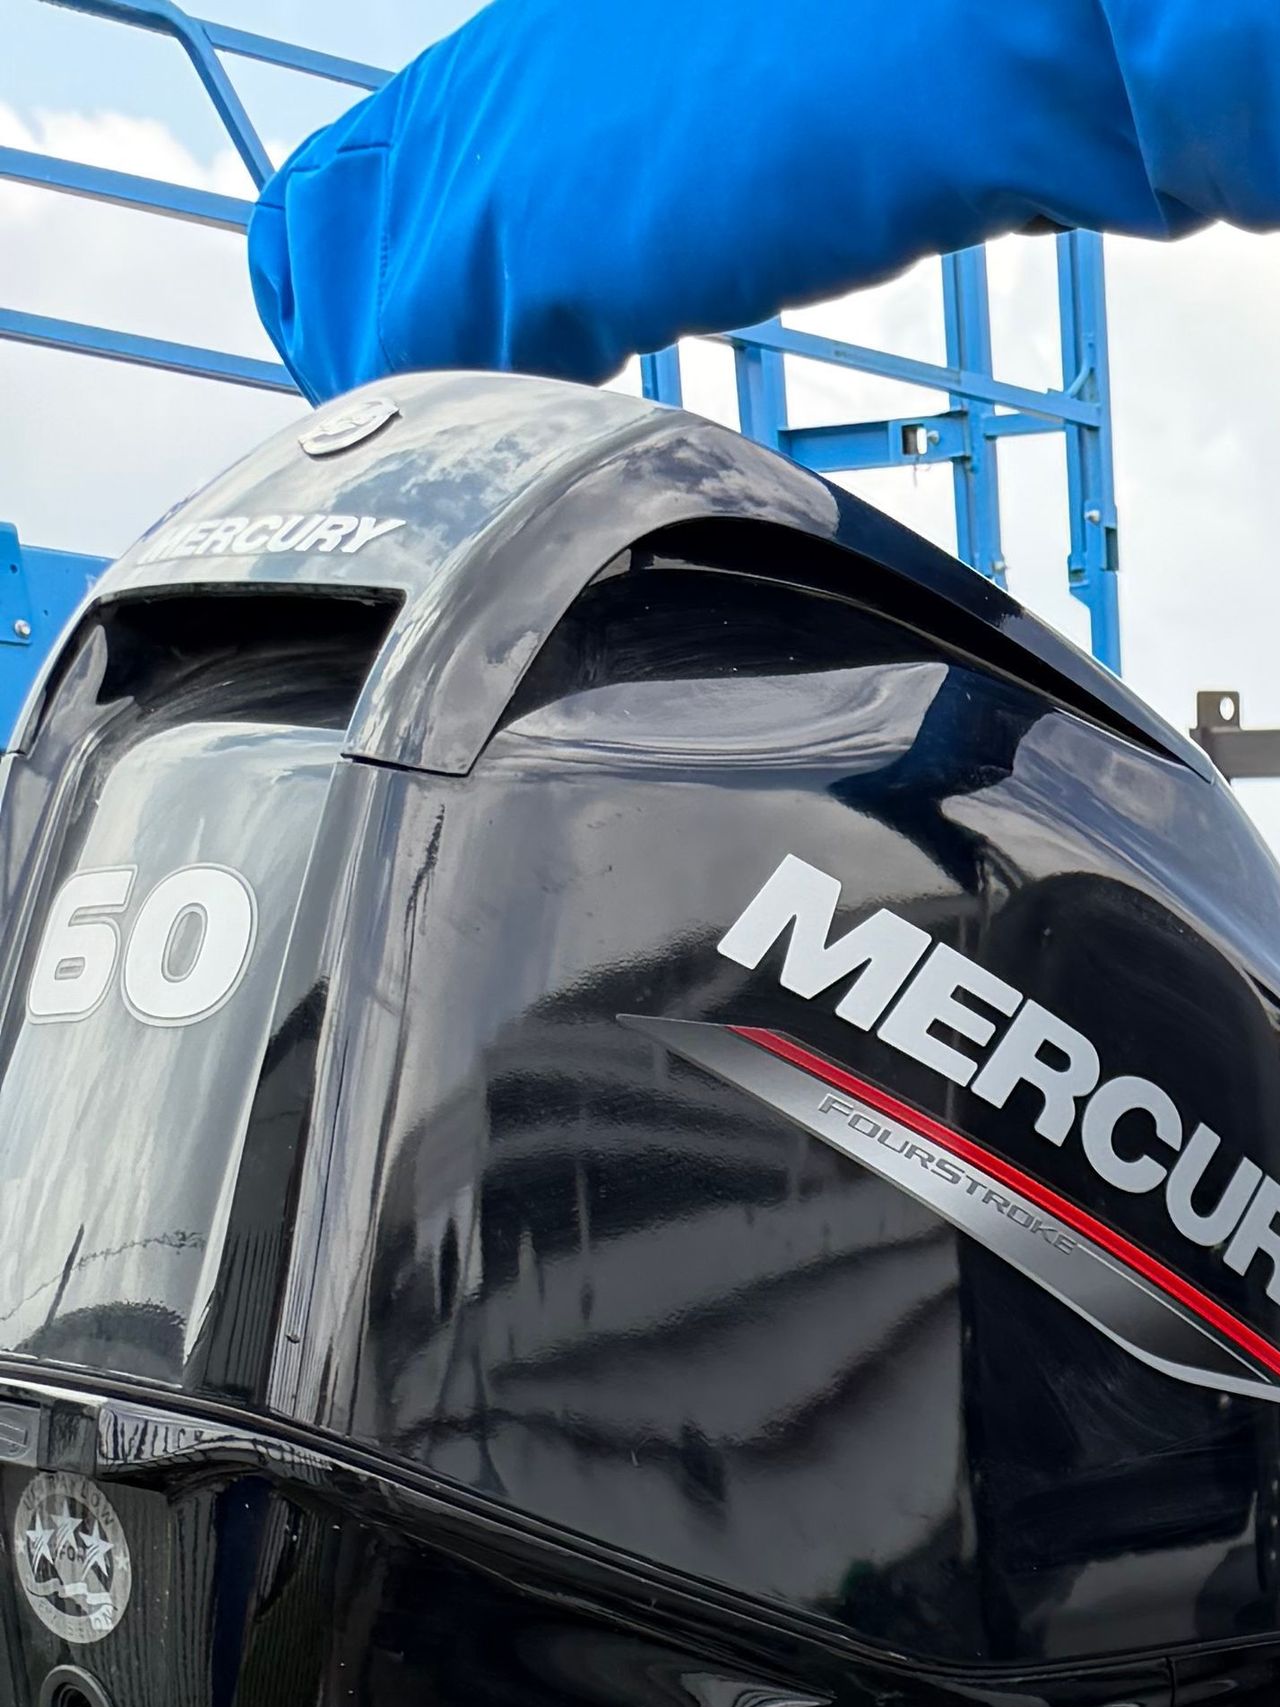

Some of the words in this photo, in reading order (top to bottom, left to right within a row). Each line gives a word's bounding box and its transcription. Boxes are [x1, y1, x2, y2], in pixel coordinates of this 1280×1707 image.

[137, 513, 407, 566] MERCURY
[28, 864, 257, 1027] 60
[818, 1093, 1077, 1255] FOURSTROKE
